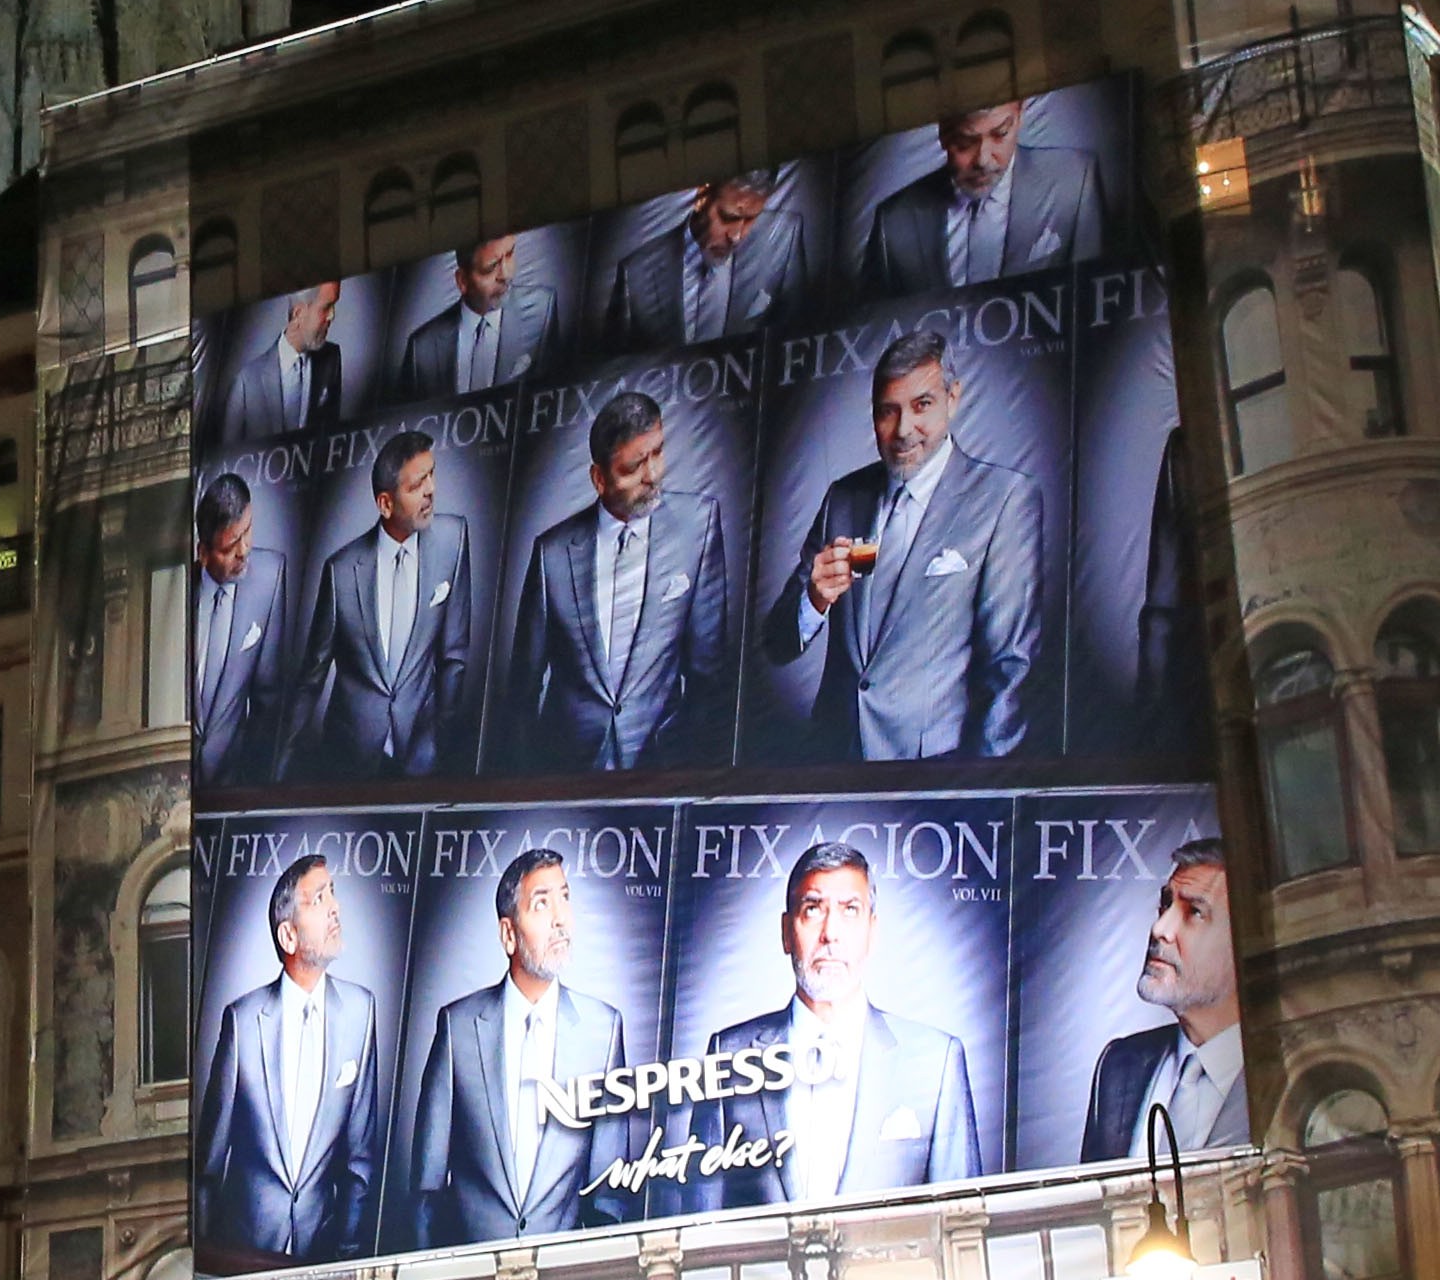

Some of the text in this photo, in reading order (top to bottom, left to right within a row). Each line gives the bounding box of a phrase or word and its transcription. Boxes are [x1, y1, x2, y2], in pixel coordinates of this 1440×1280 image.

[225, 831, 417, 877] FIXACION
[625, 884, 662, 897] VOL VII
[952, 888, 1001, 901] VOL VII
[579, 1123, 798, 1197] what else?
